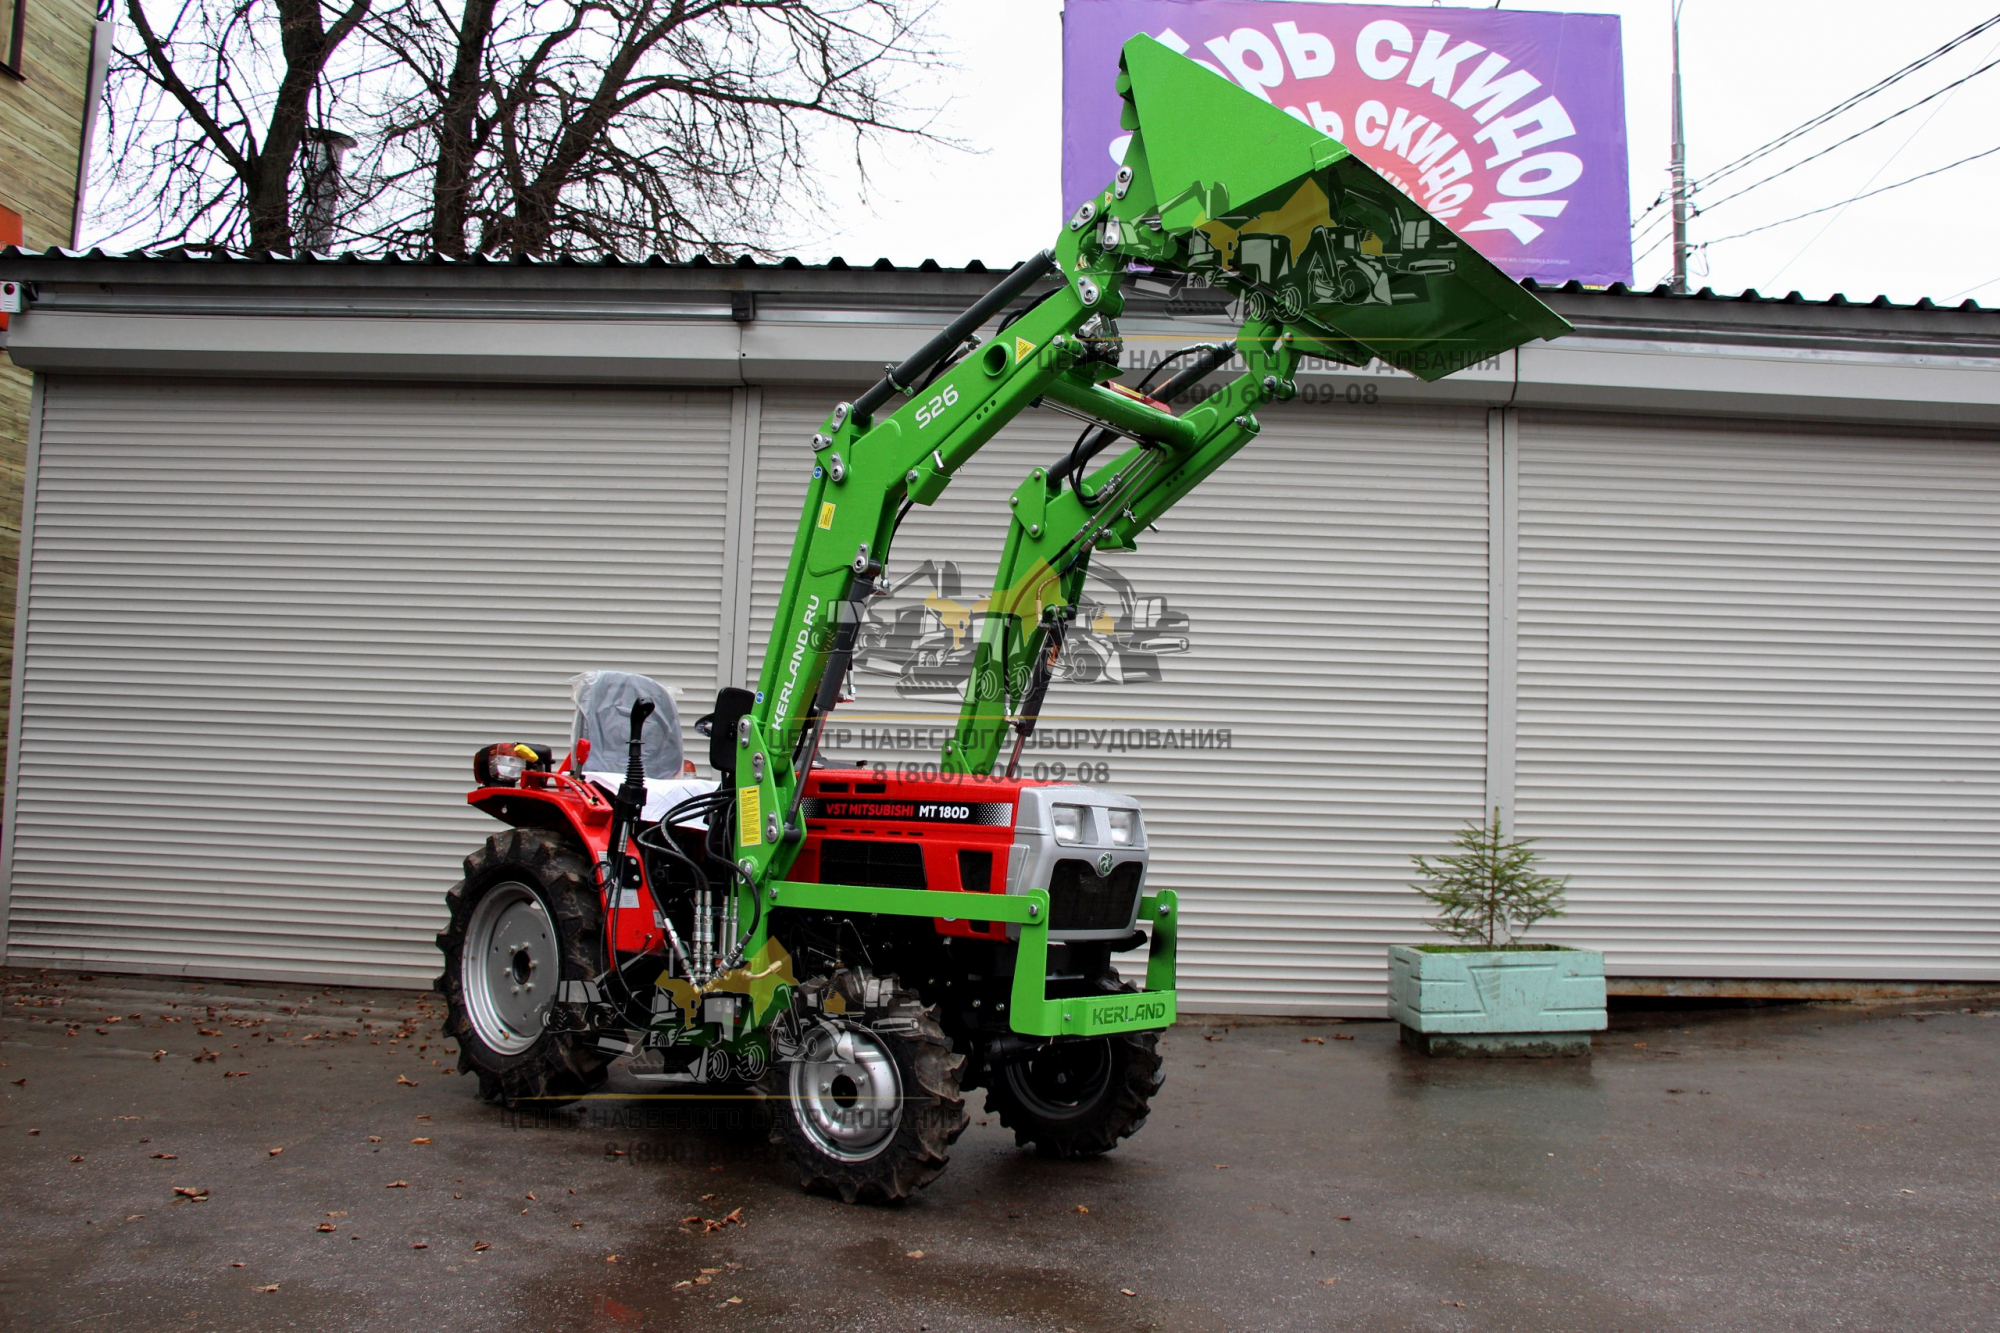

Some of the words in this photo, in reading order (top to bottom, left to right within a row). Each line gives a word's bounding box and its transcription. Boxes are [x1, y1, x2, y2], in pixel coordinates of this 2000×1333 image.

[915, 384, 959, 429] S26
[771, 594, 820, 731] KERLAND.RU
[826, 803, 848, 816] VST
[849, 803, 914, 817] MITSUBISHI
[918, 805, 938, 818] MT
[938, 805, 970, 819] 180D
[1092, 1002, 1166, 1026] KERLAND
